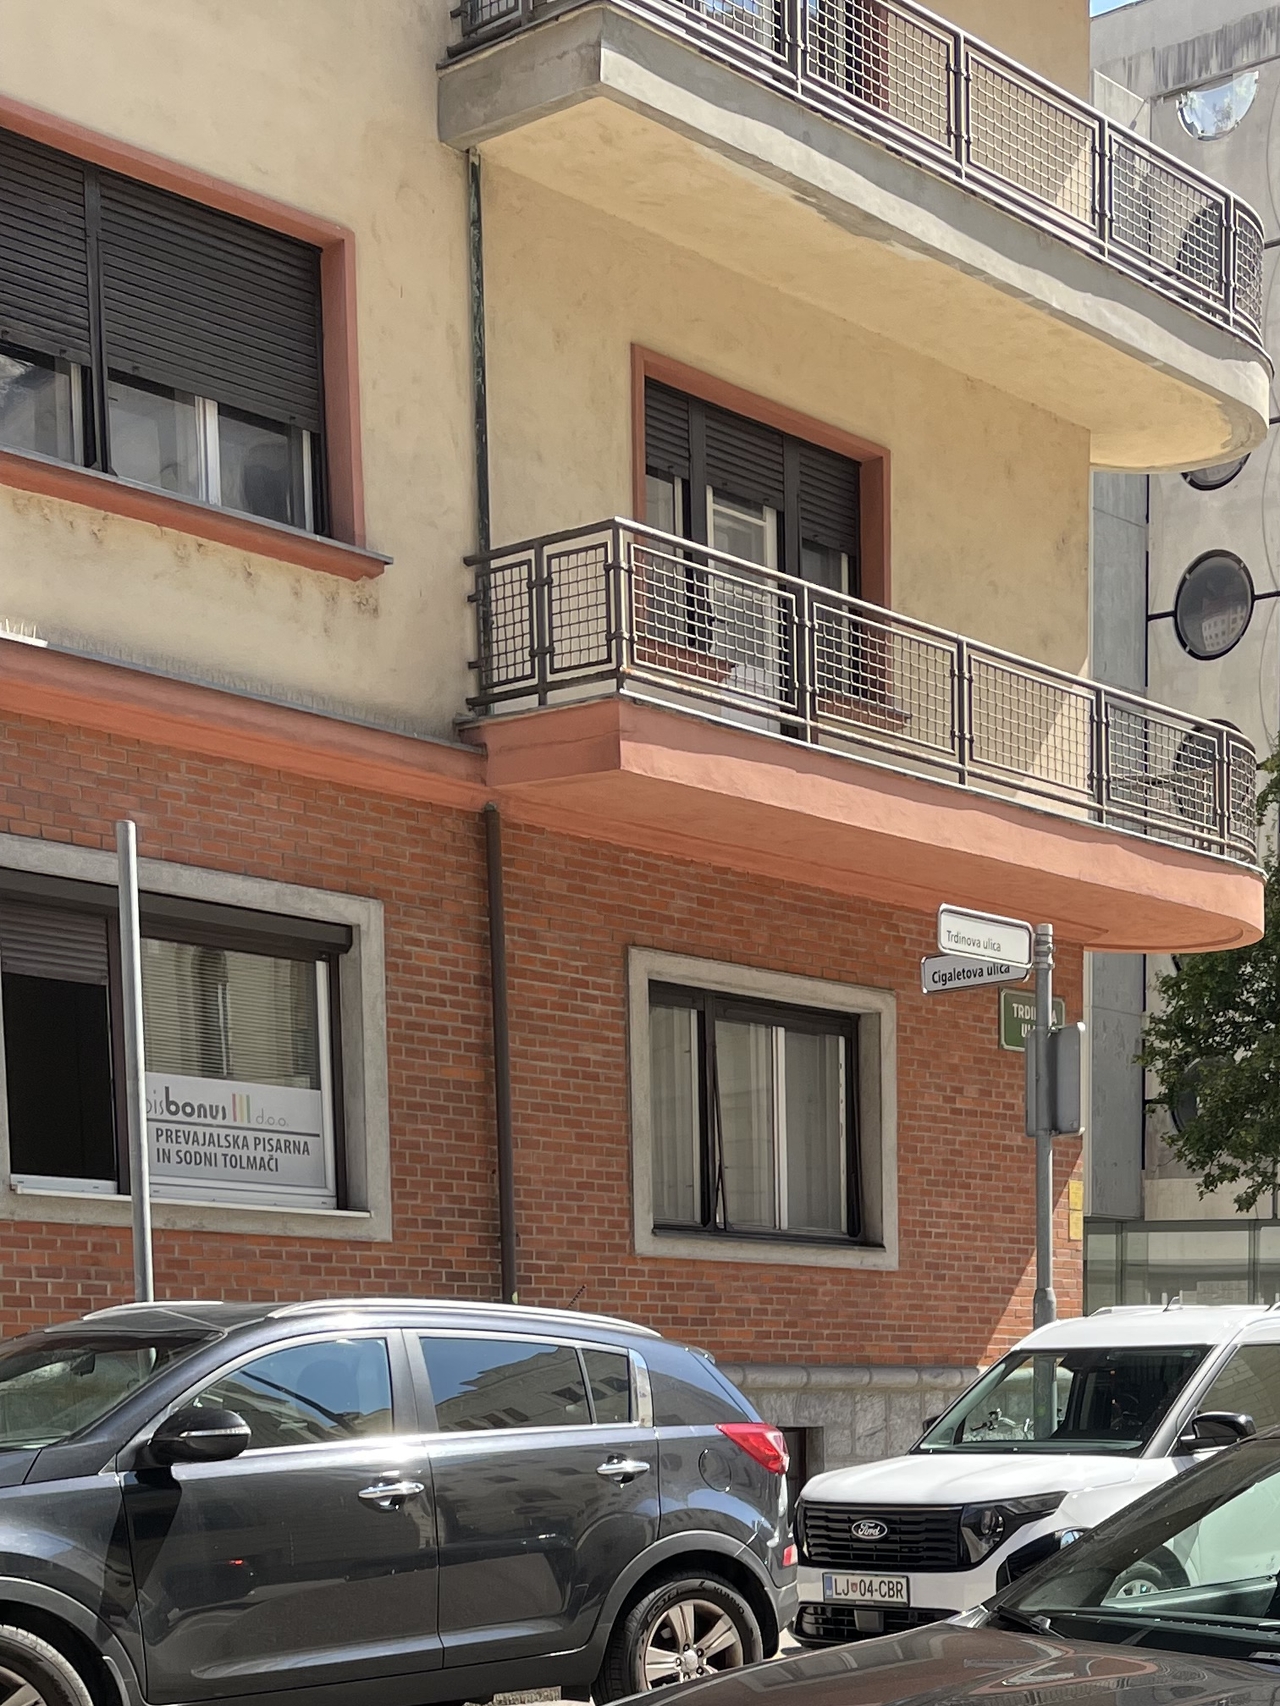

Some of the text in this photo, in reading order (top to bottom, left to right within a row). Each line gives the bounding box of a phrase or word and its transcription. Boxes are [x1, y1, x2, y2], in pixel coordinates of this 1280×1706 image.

[946, 930, 1002, 952] Trdinova ulica
[932, 962, 1010, 986] Cigaletova ulica
[155, 1127, 311, 1156] PREVAJALSKA PISARNA
[156, 1148, 279, 1172] IN SODNI TOLMAČI
[858, 1522, 880, 1536] Ford
[834, 1578, 904, 1599] LJ 04-CBR
